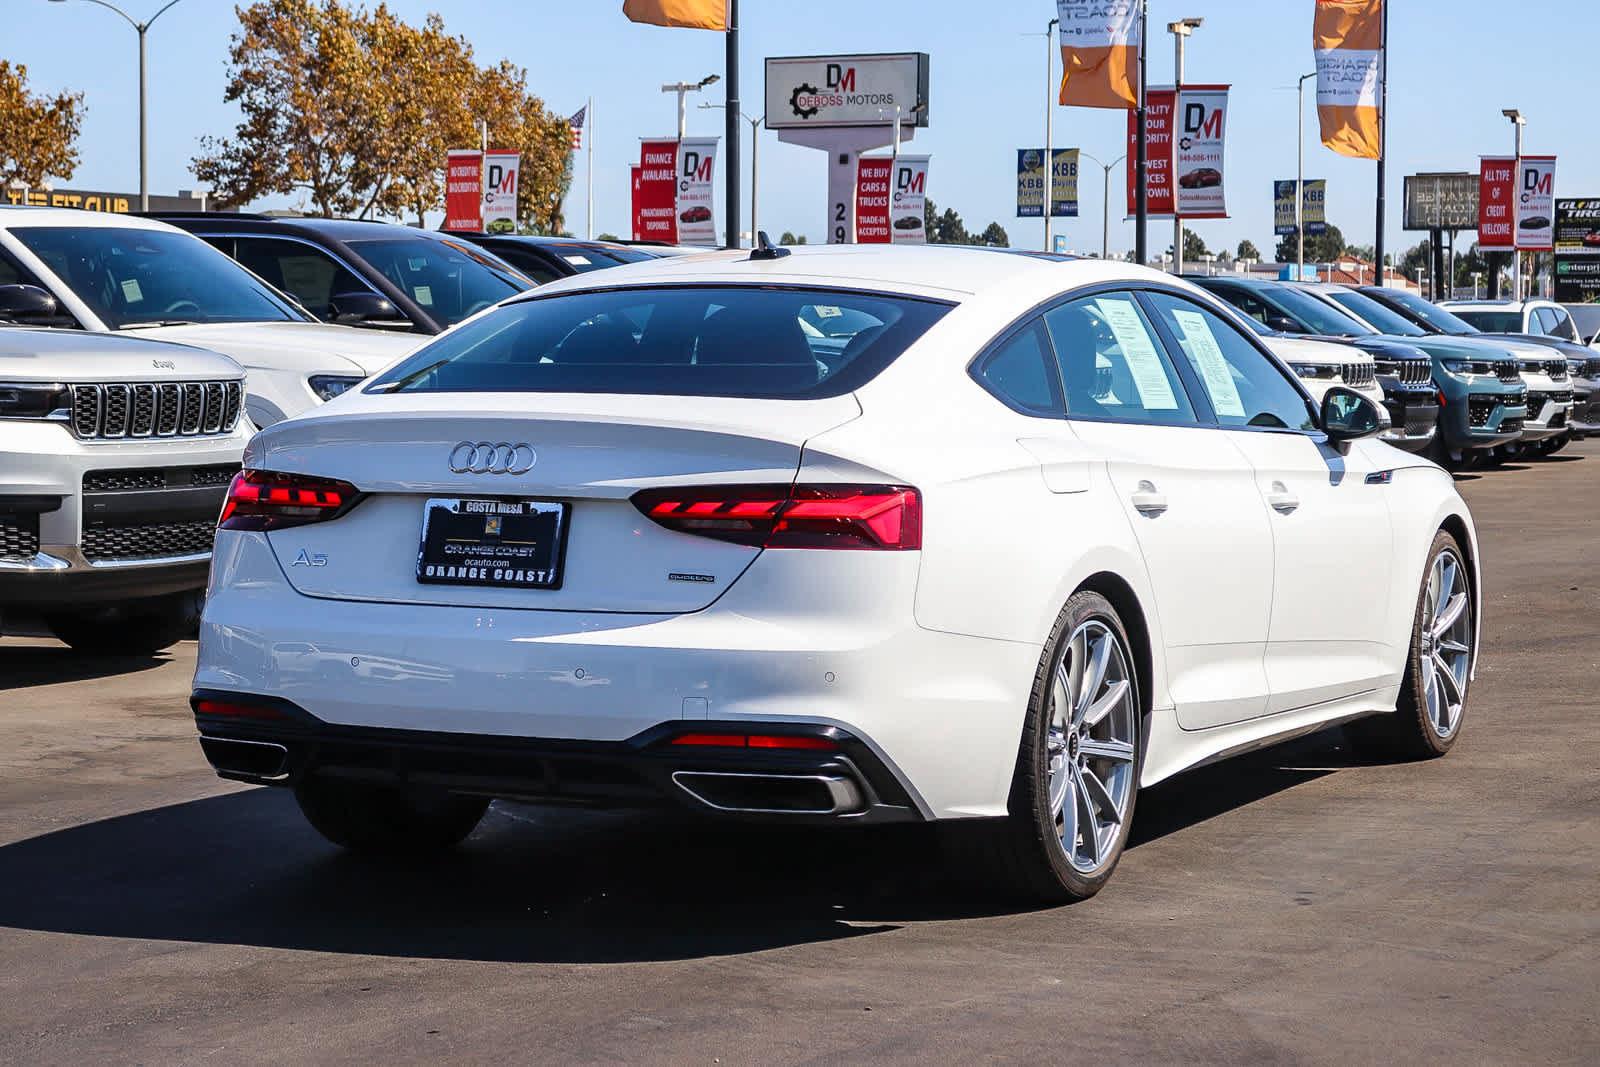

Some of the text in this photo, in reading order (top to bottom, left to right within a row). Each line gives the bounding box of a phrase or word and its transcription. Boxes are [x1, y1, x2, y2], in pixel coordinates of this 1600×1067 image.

[827, 64, 856, 92] DM
[799, 94, 894, 107] DEBOSS MOTORS
[1133, 105, 1170, 115] ALITY
[1145, 120, 1165, 129] OUR
[1185, 103, 1223, 139] DM
[1131, 134, 1170, 144] PORITY
[645, 153, 672, 164] FINANCE
[684, 152, 712, 182] DM
[862, 168, 888, 177] WE BUY
[1053, 162, 1077, 176] KBB
[489, 165, 514, 194] DM
[642, 170, 674, 181] AVAILABLE
[898, 168, 924, 194] DM
[1484, 170, 1510, 181] ALL TYPE
[861, 182, 886, 192] CARS &
[1524, 169, 1552, 194] DM
[1147, 188, 1170, 198] OWN
[1492, 187, 1500, 199] OF
[860, 196, 887, 206] TRUCKS
[1486, 205, 1506, 216] CREDIT
[859, 216, 886, 224] TRADE-IN
[859, 228, 888, 236] ACCEPTED
[1482, 224, 1510, 234] WELCOME
[466, 502, 523, 514] COSTA MESA
[444, 544, 536, 556] ORANGE COAST
[292, 548, 328, 567] A5
[464, 558, 510, 567] ocauto.com
[426, 566, 546, 582] ORANGE COAST
